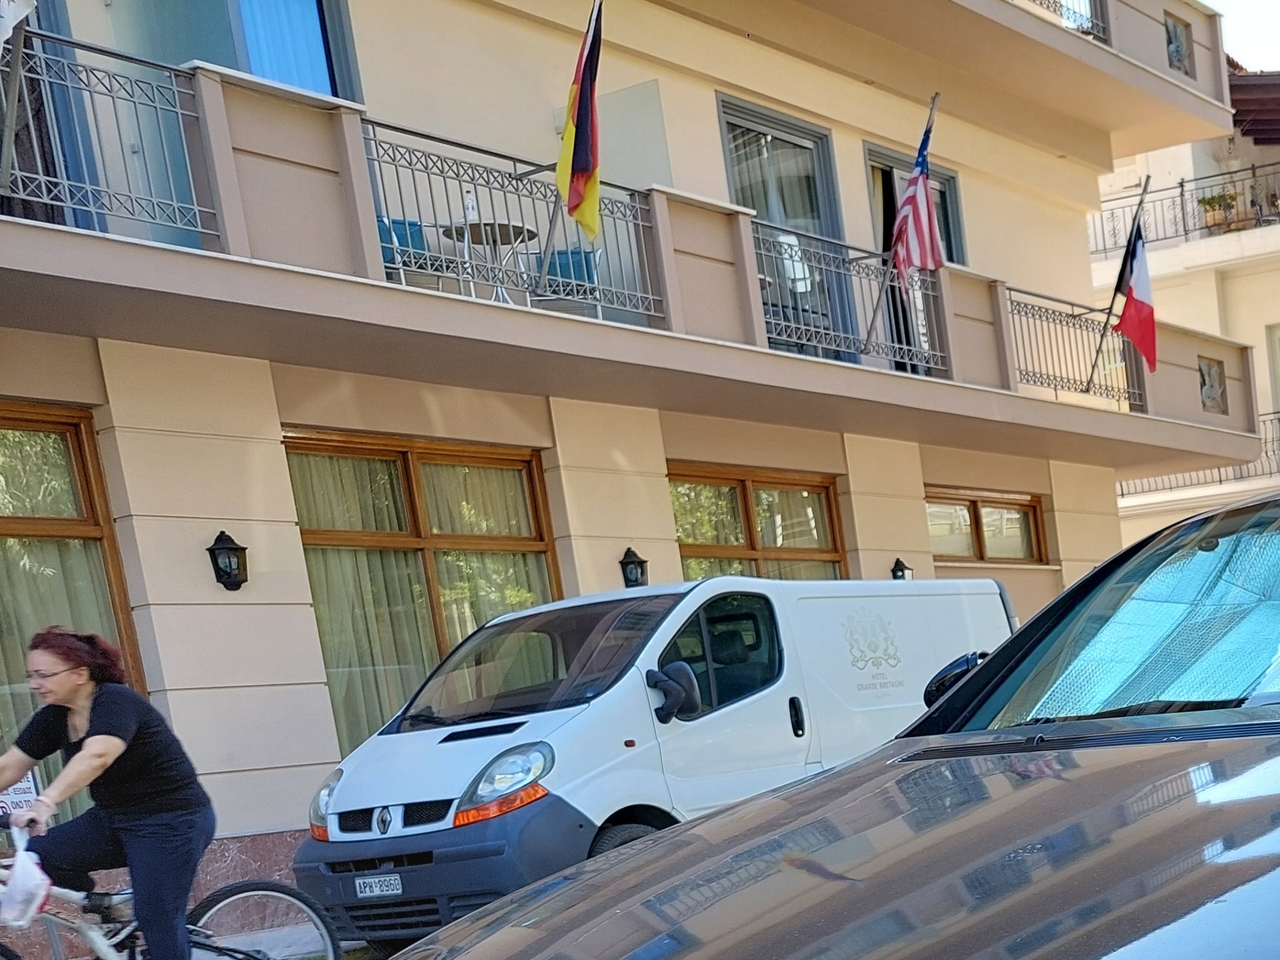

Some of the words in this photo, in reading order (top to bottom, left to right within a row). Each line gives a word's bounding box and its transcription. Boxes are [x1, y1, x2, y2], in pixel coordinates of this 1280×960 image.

[871, 672, 888, 681] HOTEL
[857, 682, 878, 692] GRANDE
[879, 680, 905, 689] BRETAGNE
